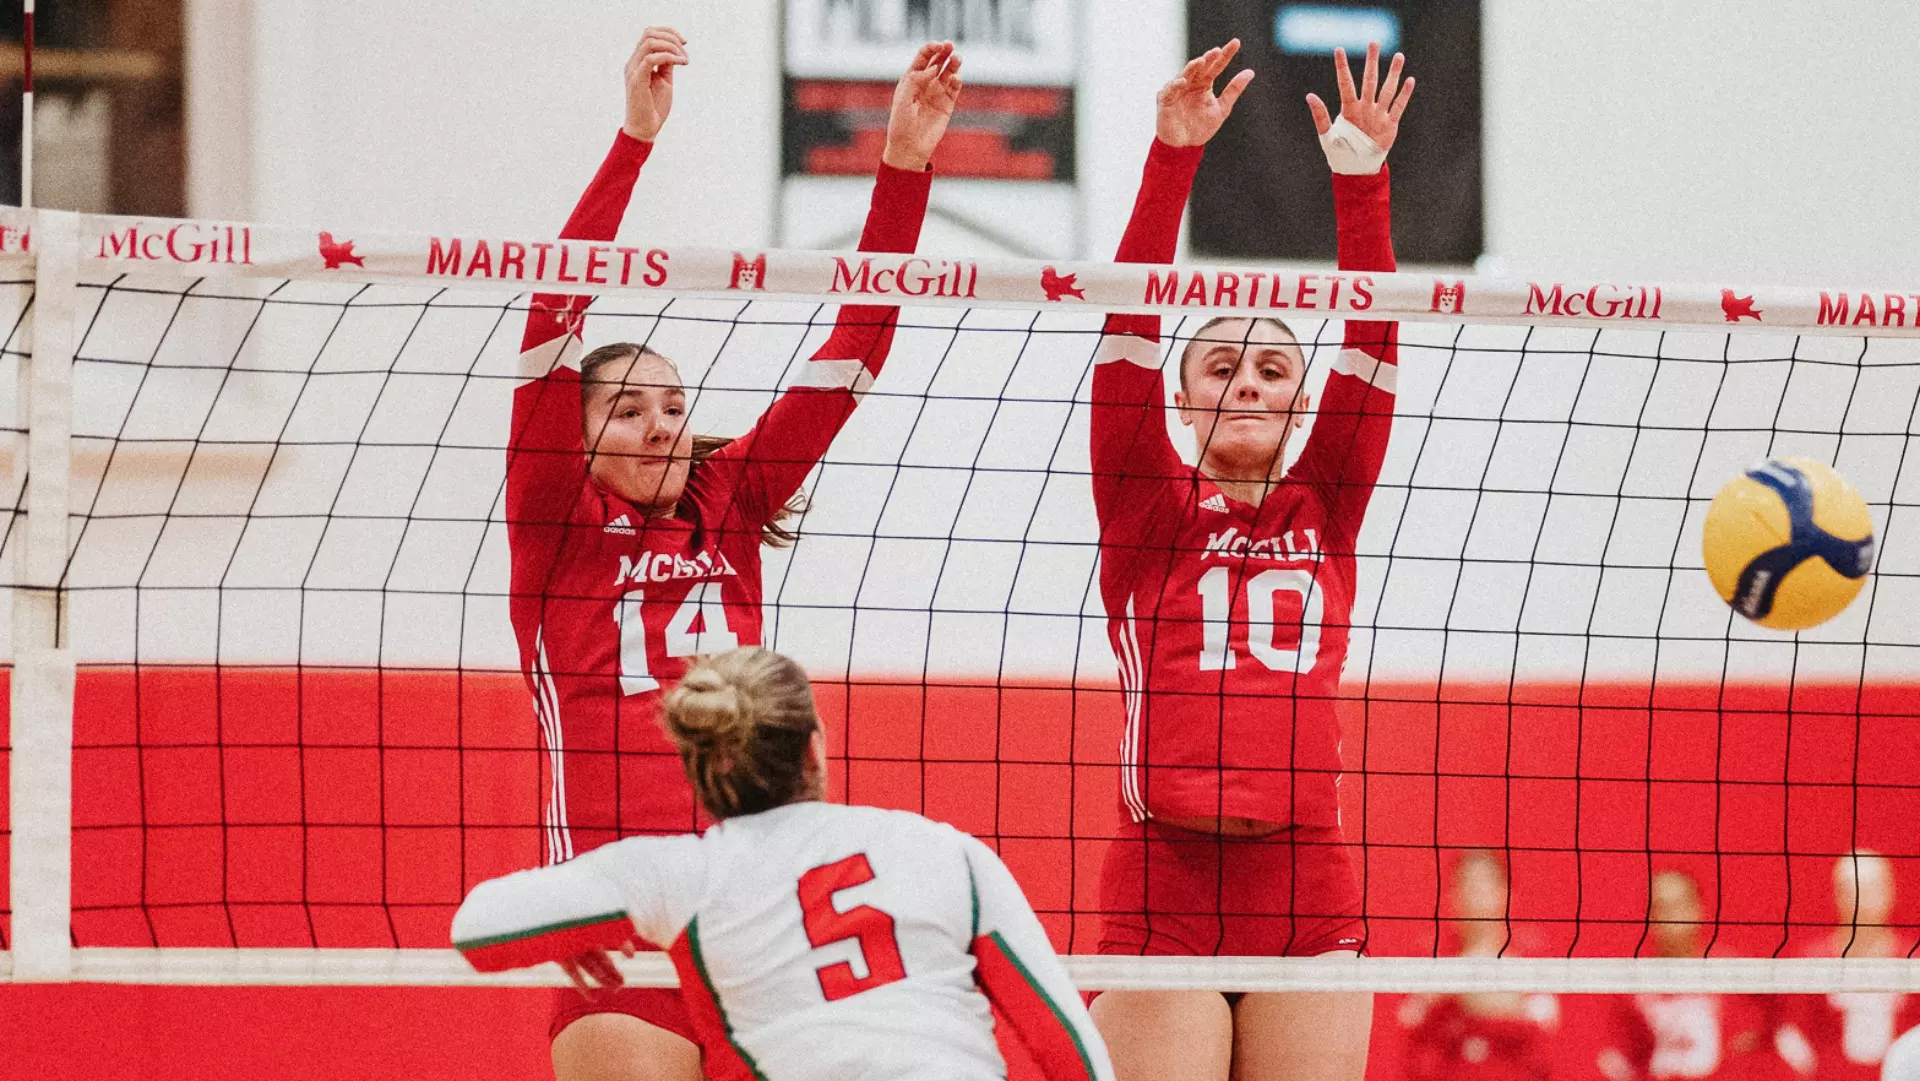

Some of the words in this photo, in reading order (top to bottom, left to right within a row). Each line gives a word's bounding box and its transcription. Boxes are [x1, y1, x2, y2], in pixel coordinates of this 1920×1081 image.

[97, 223, 253, 265] McGill
[425, 237, 670, 288] MARTLETS
[830, 257, 978, 298] McGill
[1143, 270, 1375, 312] MARTLETS
[1523, 283, 1662, 320] McGill
[613, 582, 739, 697] 14
[1198, 566, 1325, 675] 10
[797, 852, 908, 1003] 5
